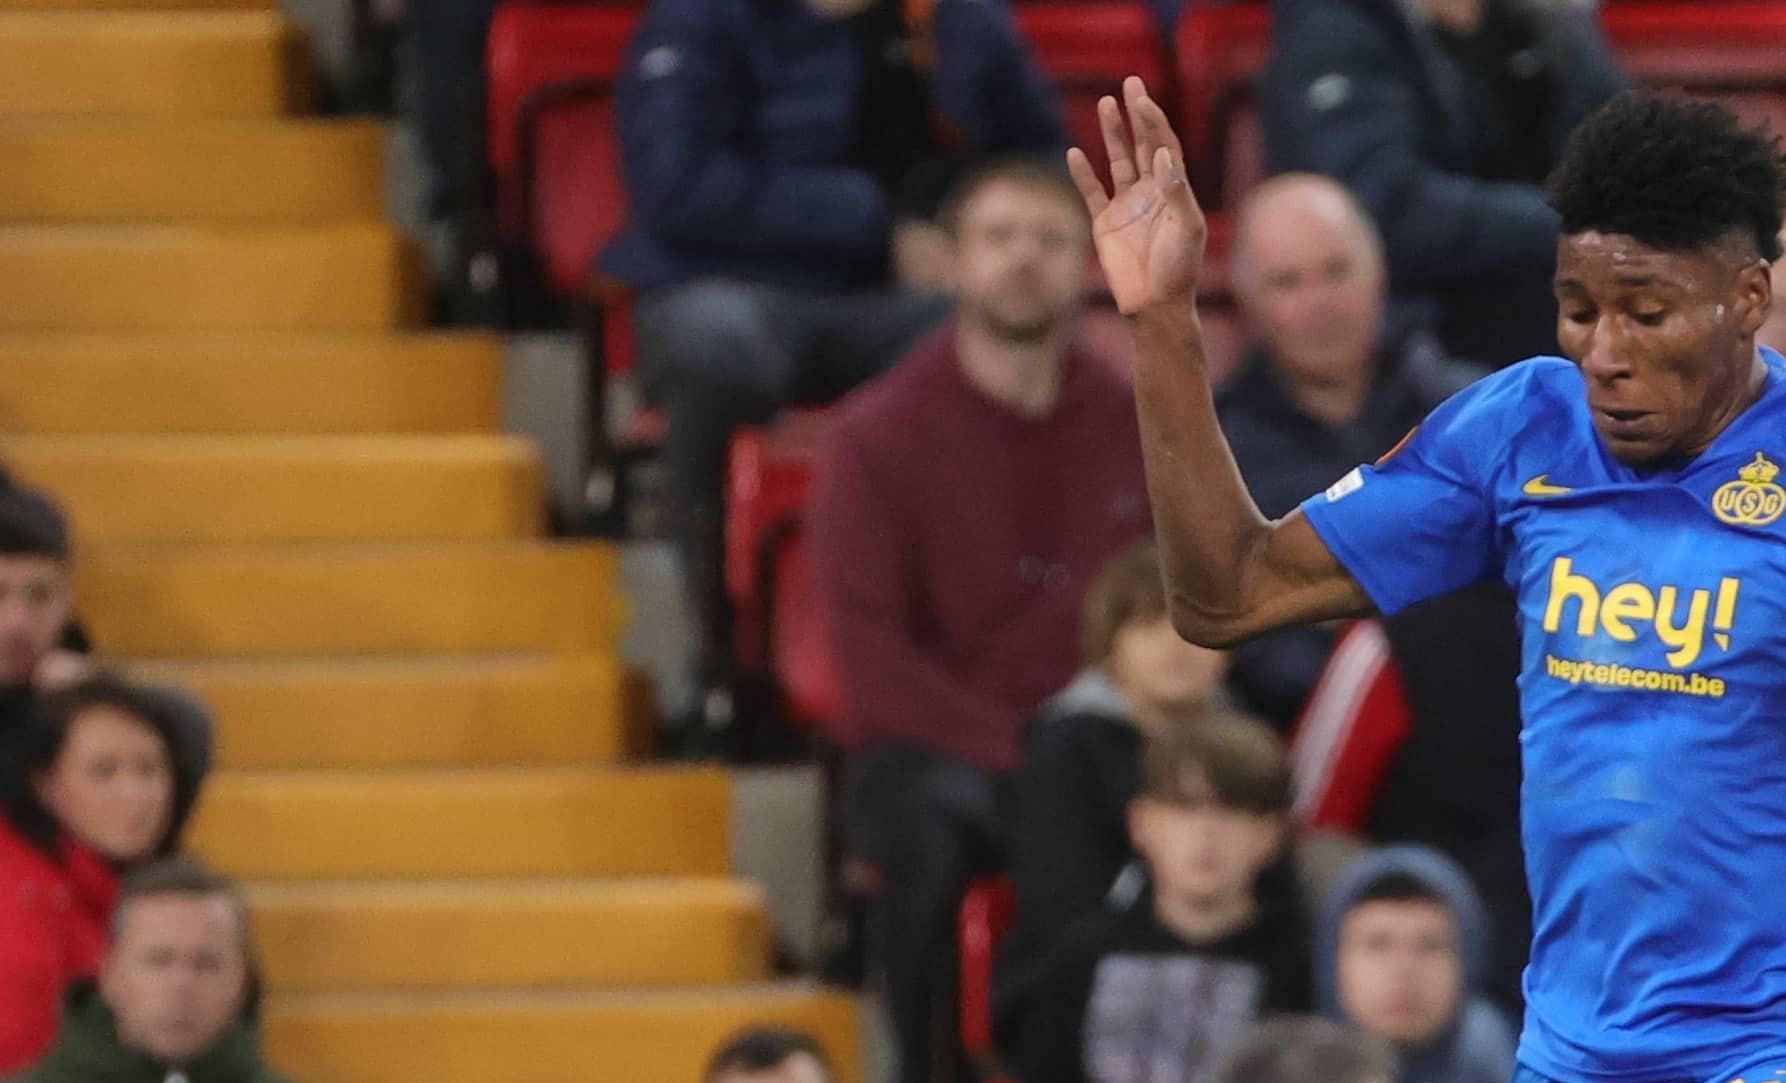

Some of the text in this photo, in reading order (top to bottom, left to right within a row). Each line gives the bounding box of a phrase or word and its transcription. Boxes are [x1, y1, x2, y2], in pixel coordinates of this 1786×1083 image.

[1718, 486, 1781, 517] USG
[1543, 556, 1740, 668] hey!
[1546, 654, 1726, 697] heytelecom.be
